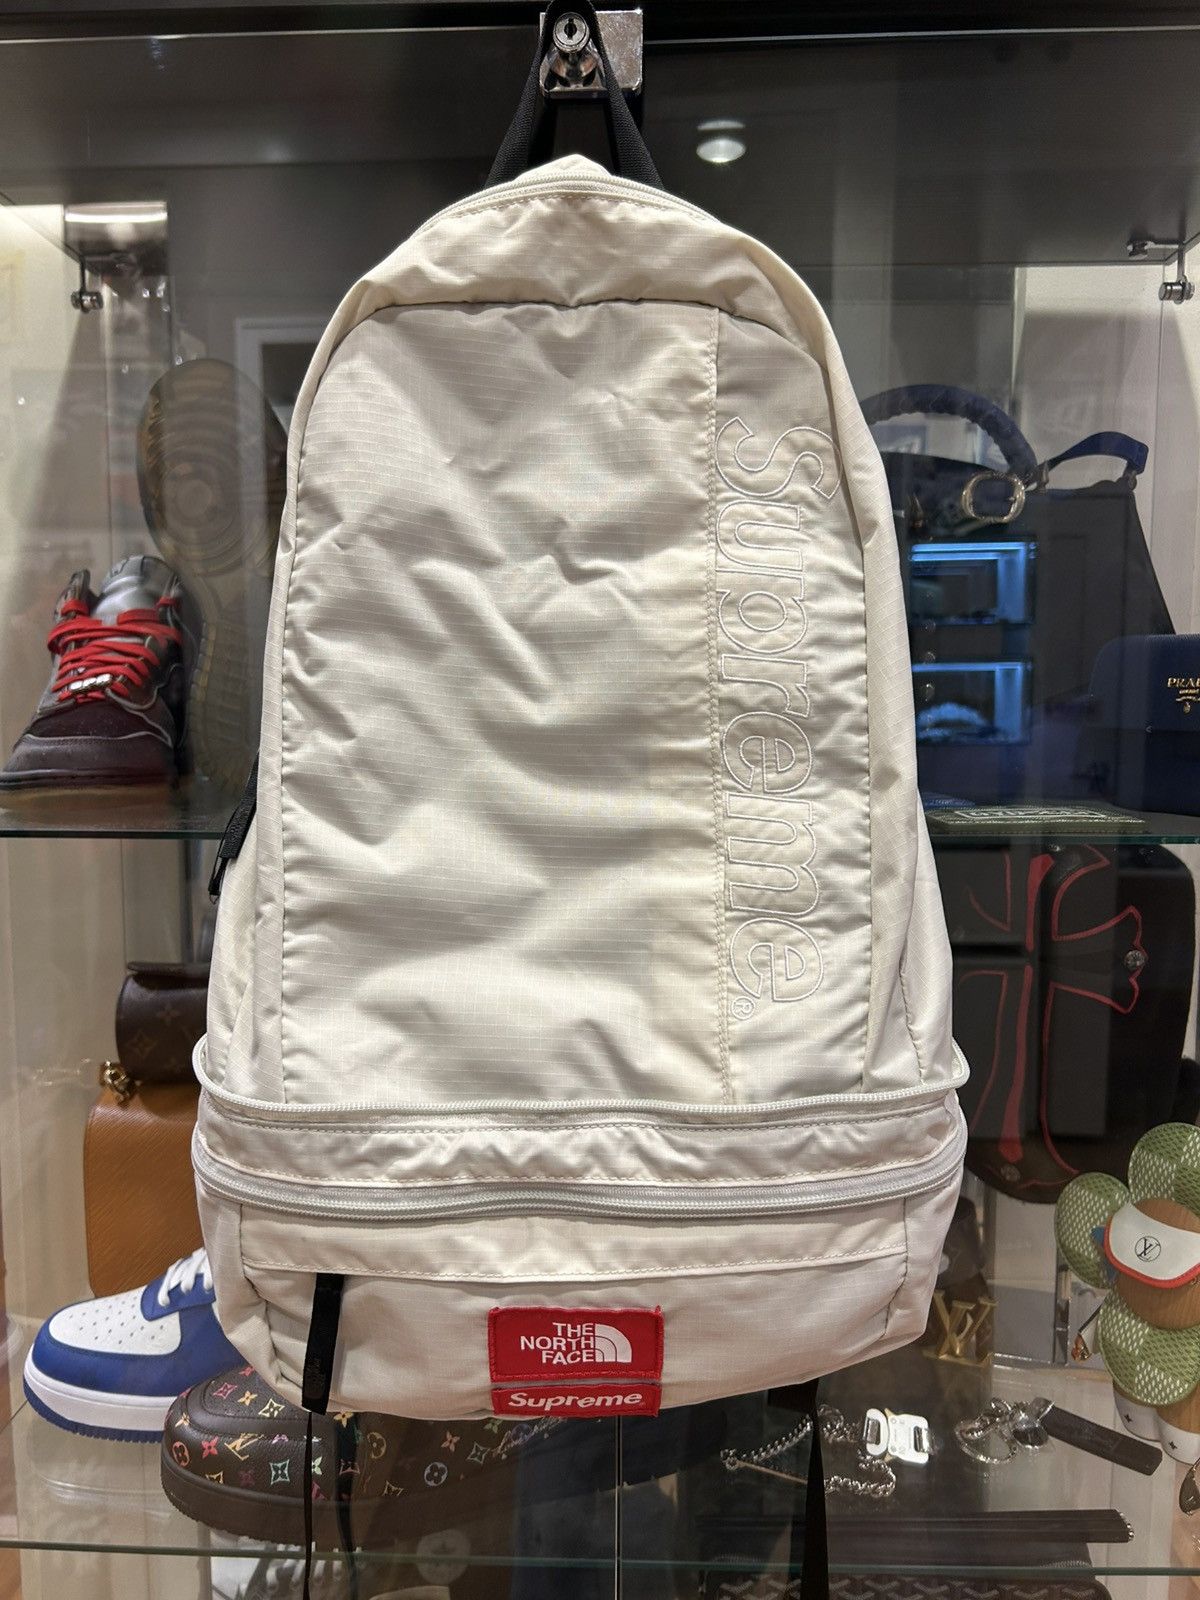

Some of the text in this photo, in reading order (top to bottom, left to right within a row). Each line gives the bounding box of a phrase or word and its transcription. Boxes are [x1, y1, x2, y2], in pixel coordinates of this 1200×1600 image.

[714, 415, 844, 1004] Supreme
[552, 1322, 594, 1338] THE
[520, 1336, 594, 1351] NORTH
[542, 1350, 594, 1365] FACE
[508, 1392, 642, 1411] Supreme
